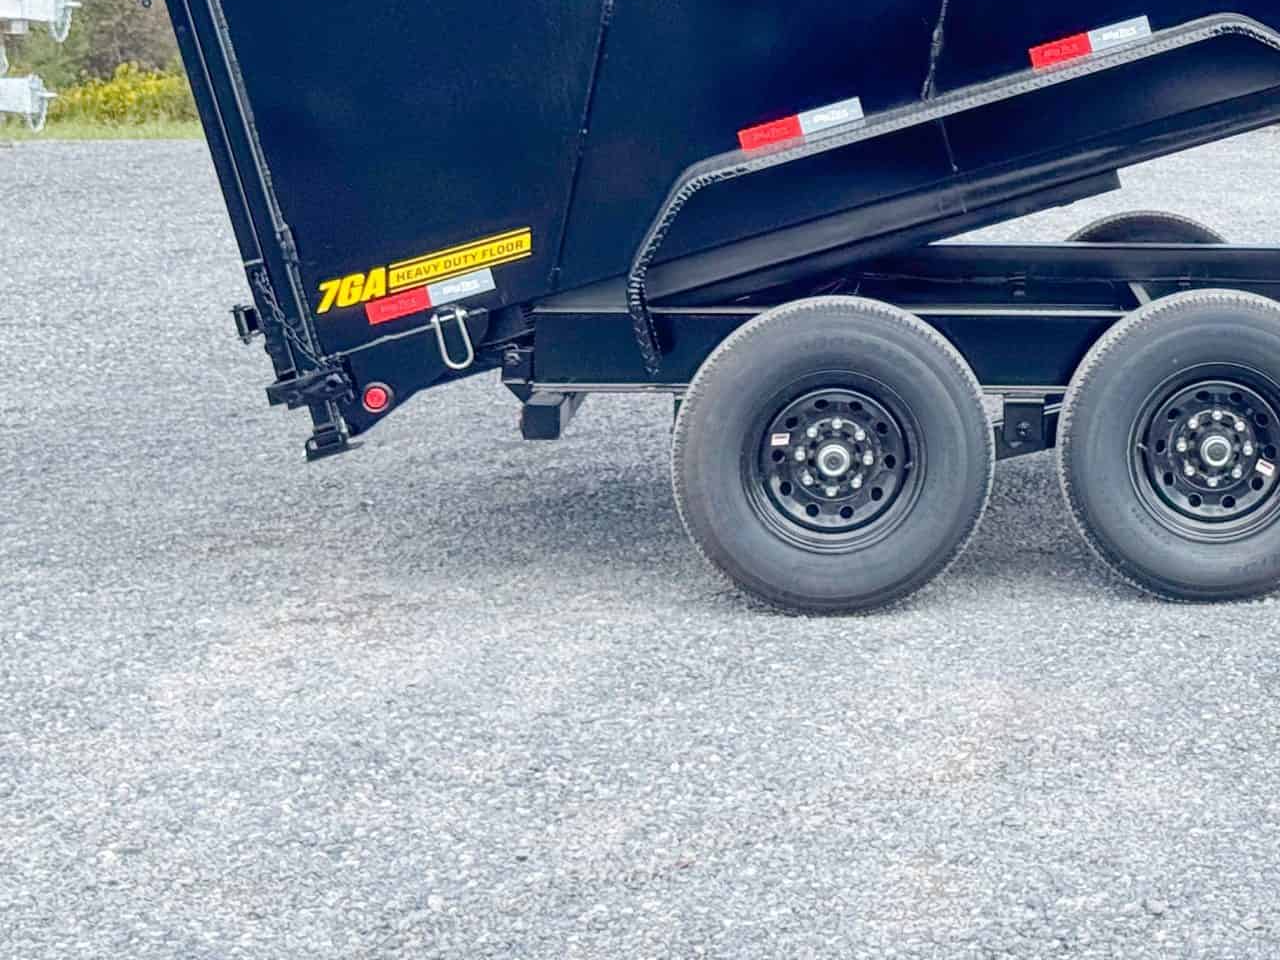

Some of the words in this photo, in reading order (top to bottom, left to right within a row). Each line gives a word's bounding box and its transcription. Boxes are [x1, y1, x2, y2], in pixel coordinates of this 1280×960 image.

[316, 267, 387, 314] 7GA
[396, 262, 441, 283] HEAVY
[443, 251, 480, 269] DUTY
[481, 239, 524, 259] FLOOR
